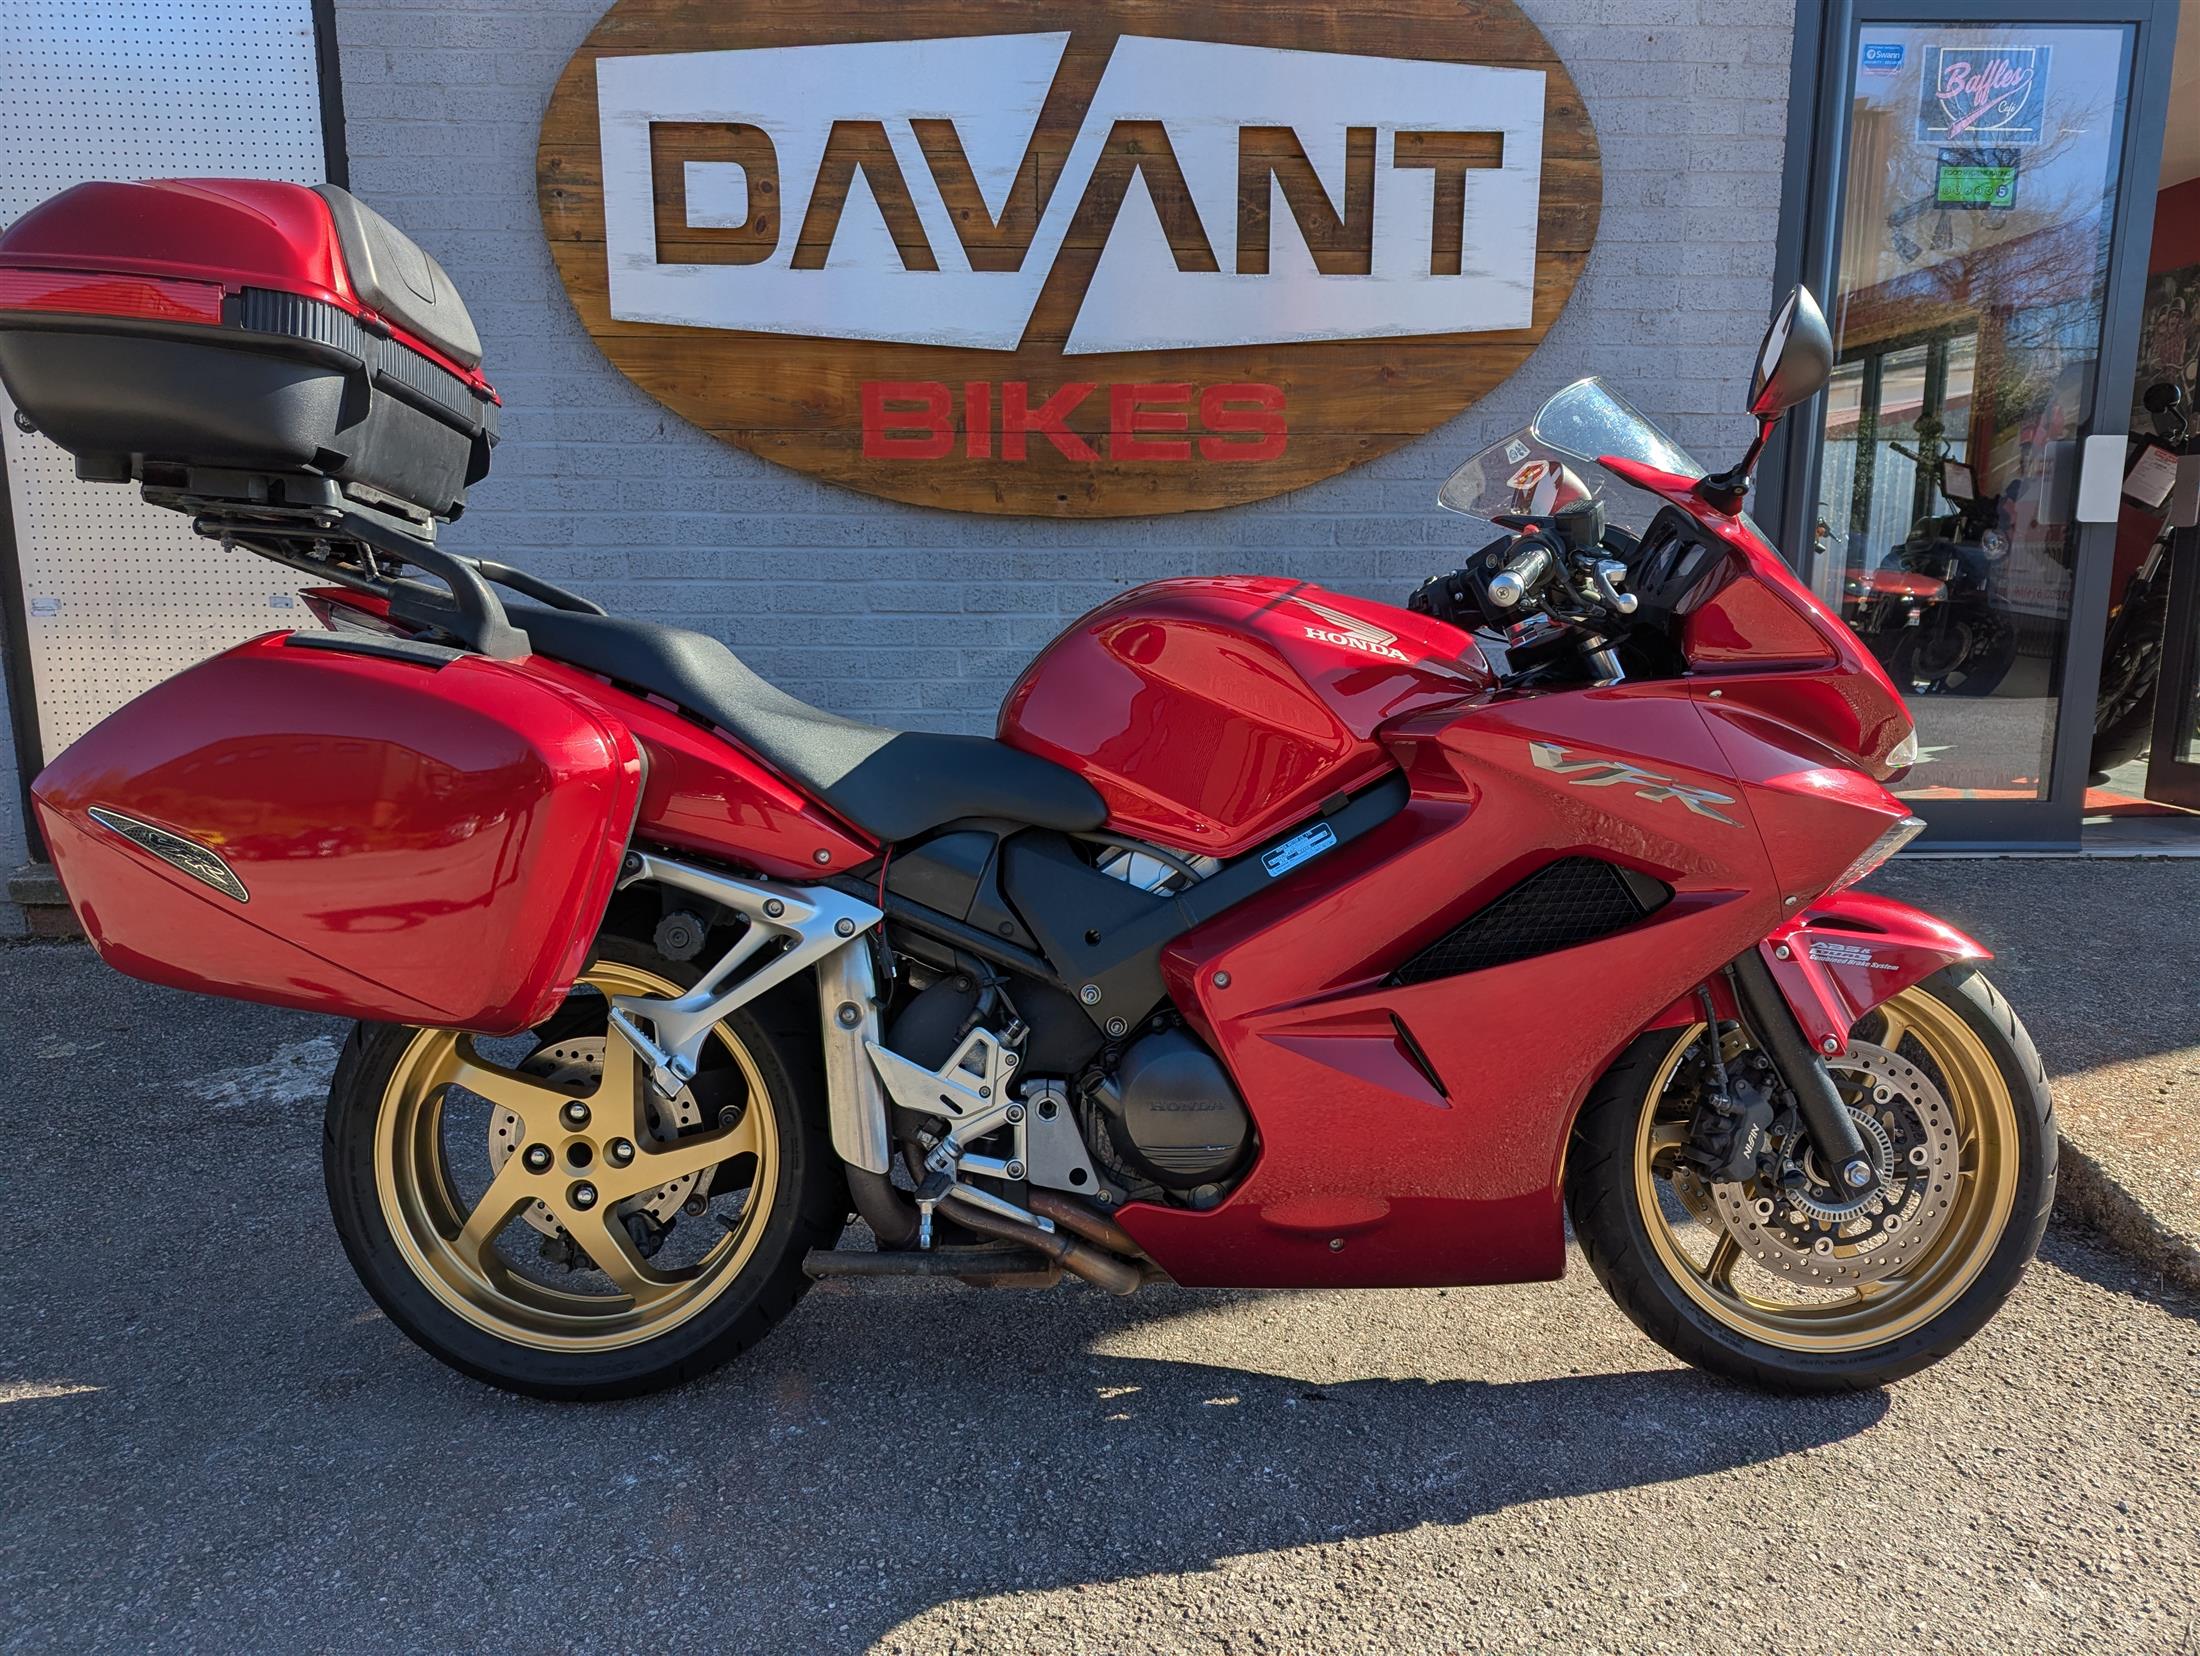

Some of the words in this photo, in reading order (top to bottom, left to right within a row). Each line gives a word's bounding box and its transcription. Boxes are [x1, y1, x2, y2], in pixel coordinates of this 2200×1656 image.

[1876, 50, 1900, 59] Swann
[1936, 59, 2033, 107] Baffles
[649, 119, 1505, 277] DAVANT
[1998, 186, 2006, 197] 5
[861, 381, 1288, 461] BIKES
[1304, 627, 1410, 662] HONDA
[1529, 740, 1745, 829] VFR
[1810, 942, 1861, 953] ABS
[1809, 954, 1848, 964] Combined
[1847, 959, 1871, 967] Brake
[1870, 962, 1900, 971] System
[1150, 1101, 1225, 1112] HONDA
